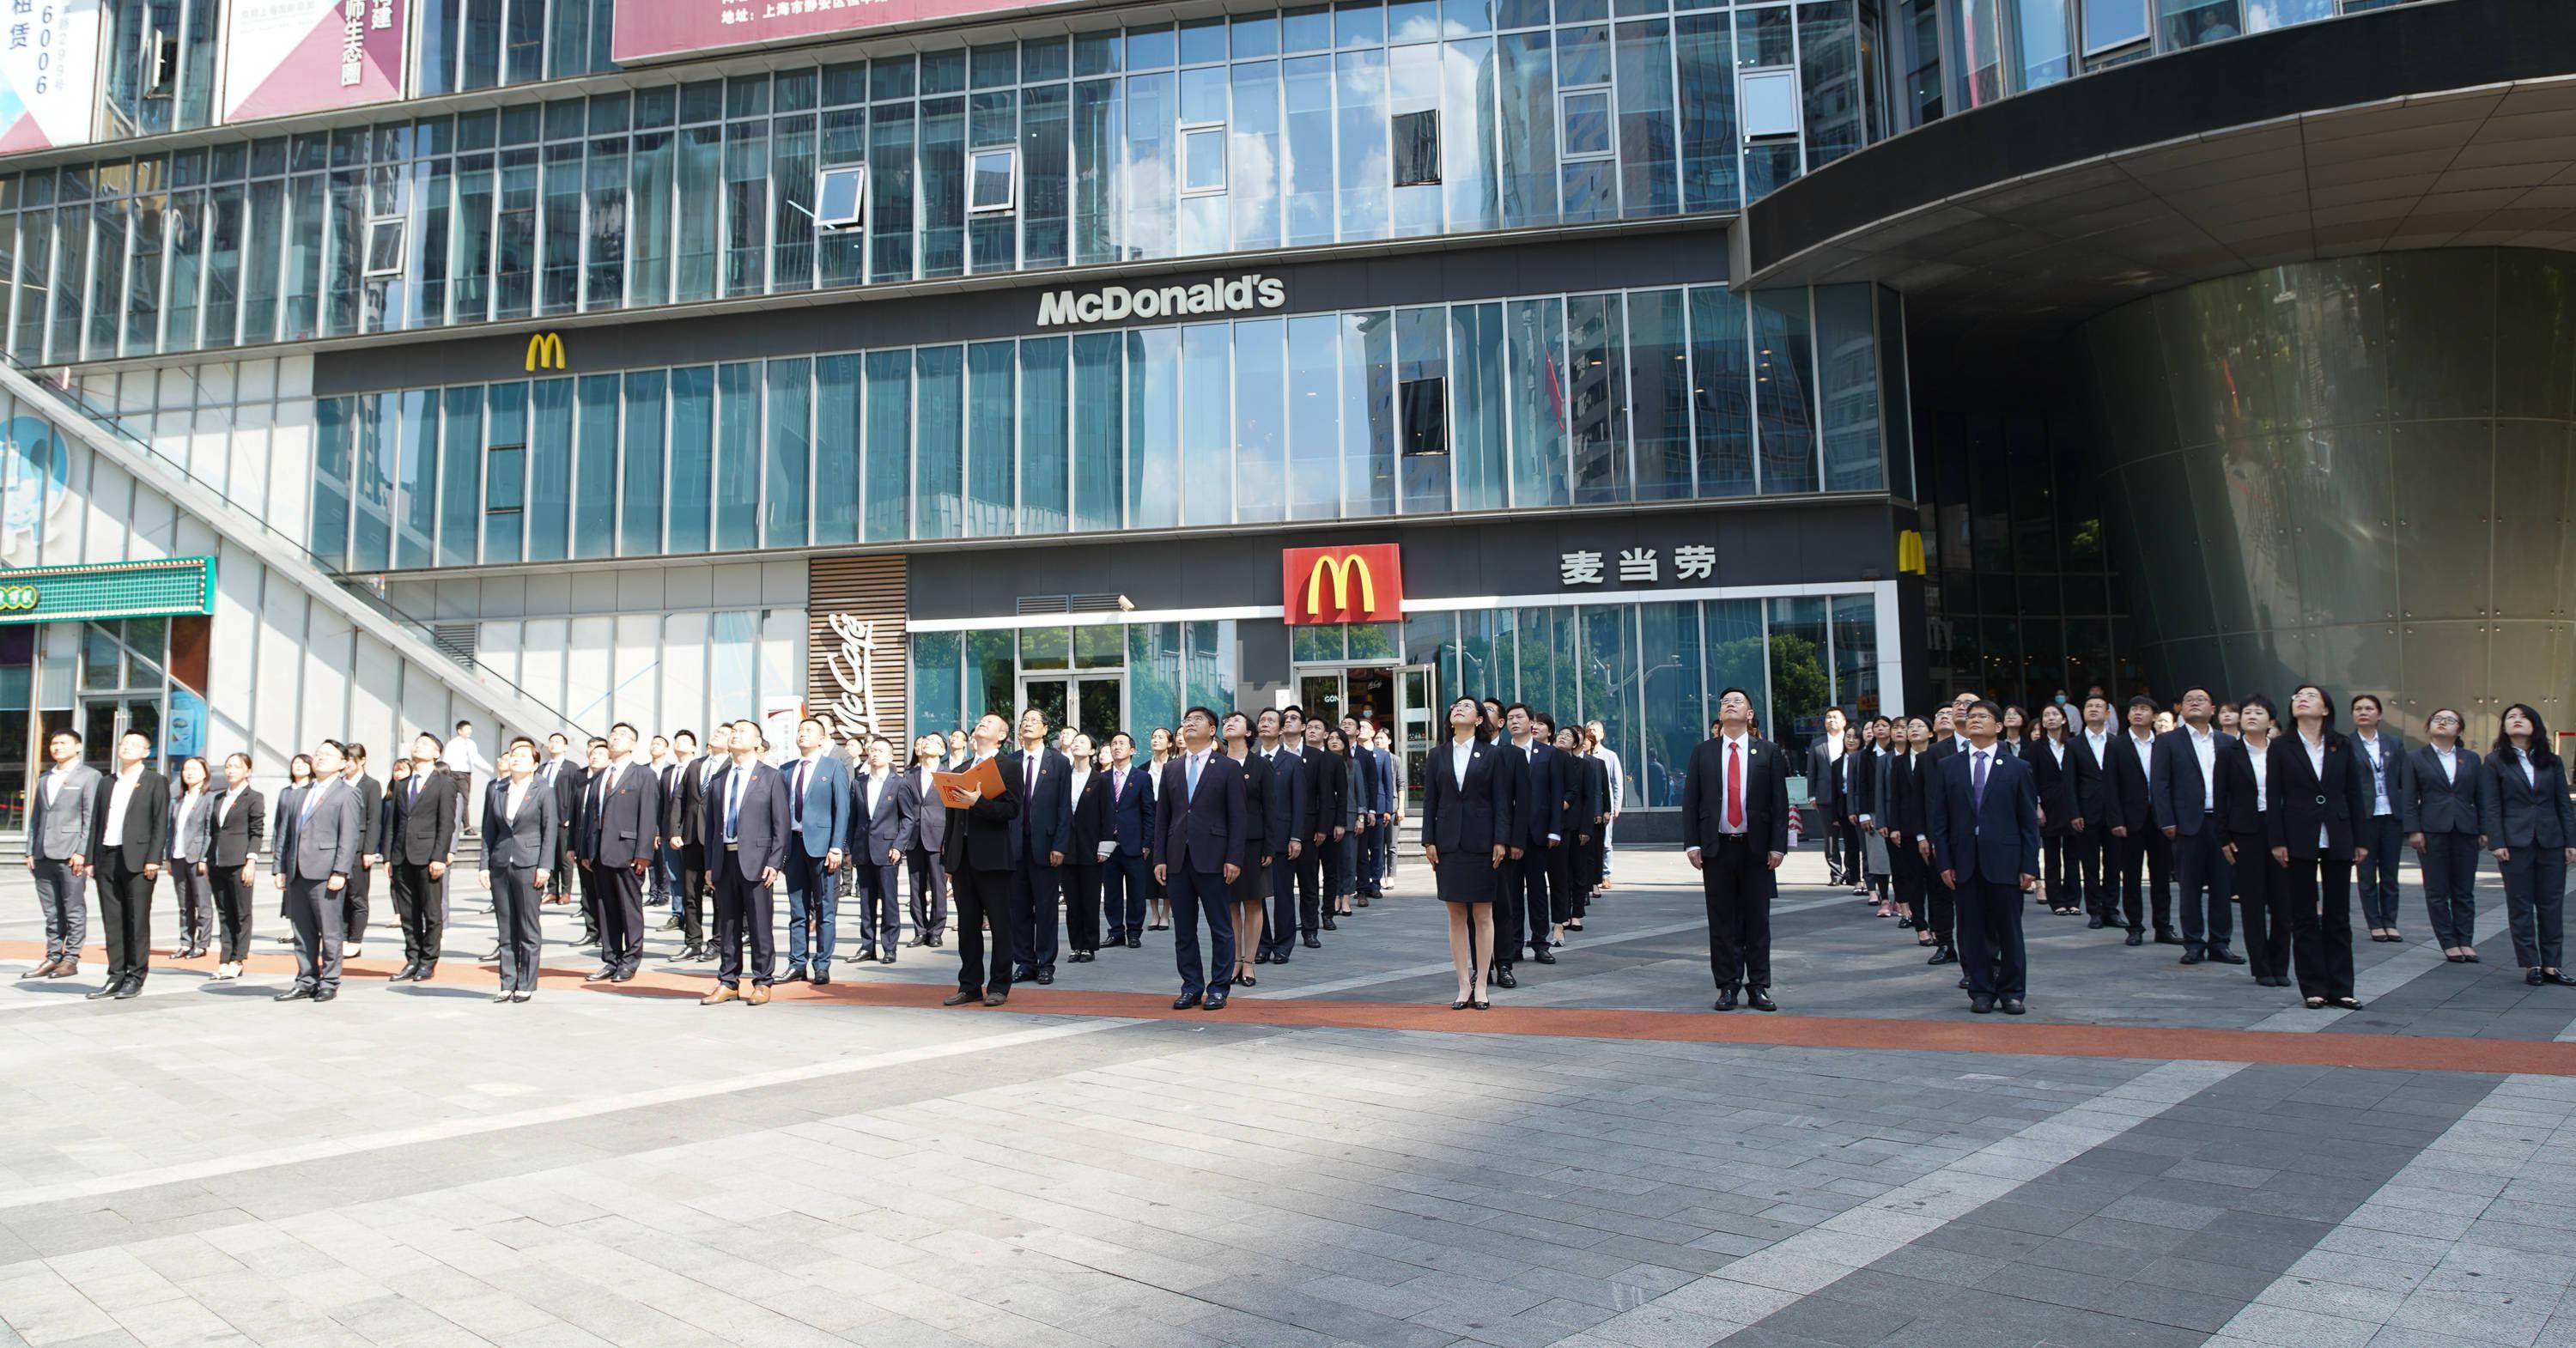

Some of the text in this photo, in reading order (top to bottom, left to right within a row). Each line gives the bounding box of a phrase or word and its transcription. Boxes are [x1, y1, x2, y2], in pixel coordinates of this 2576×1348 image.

[36, 5, 52, 94] 6006
[1037, 274, 1285, 327] McDonald's
[1561, 544, 1716, 586] 麦当劳
